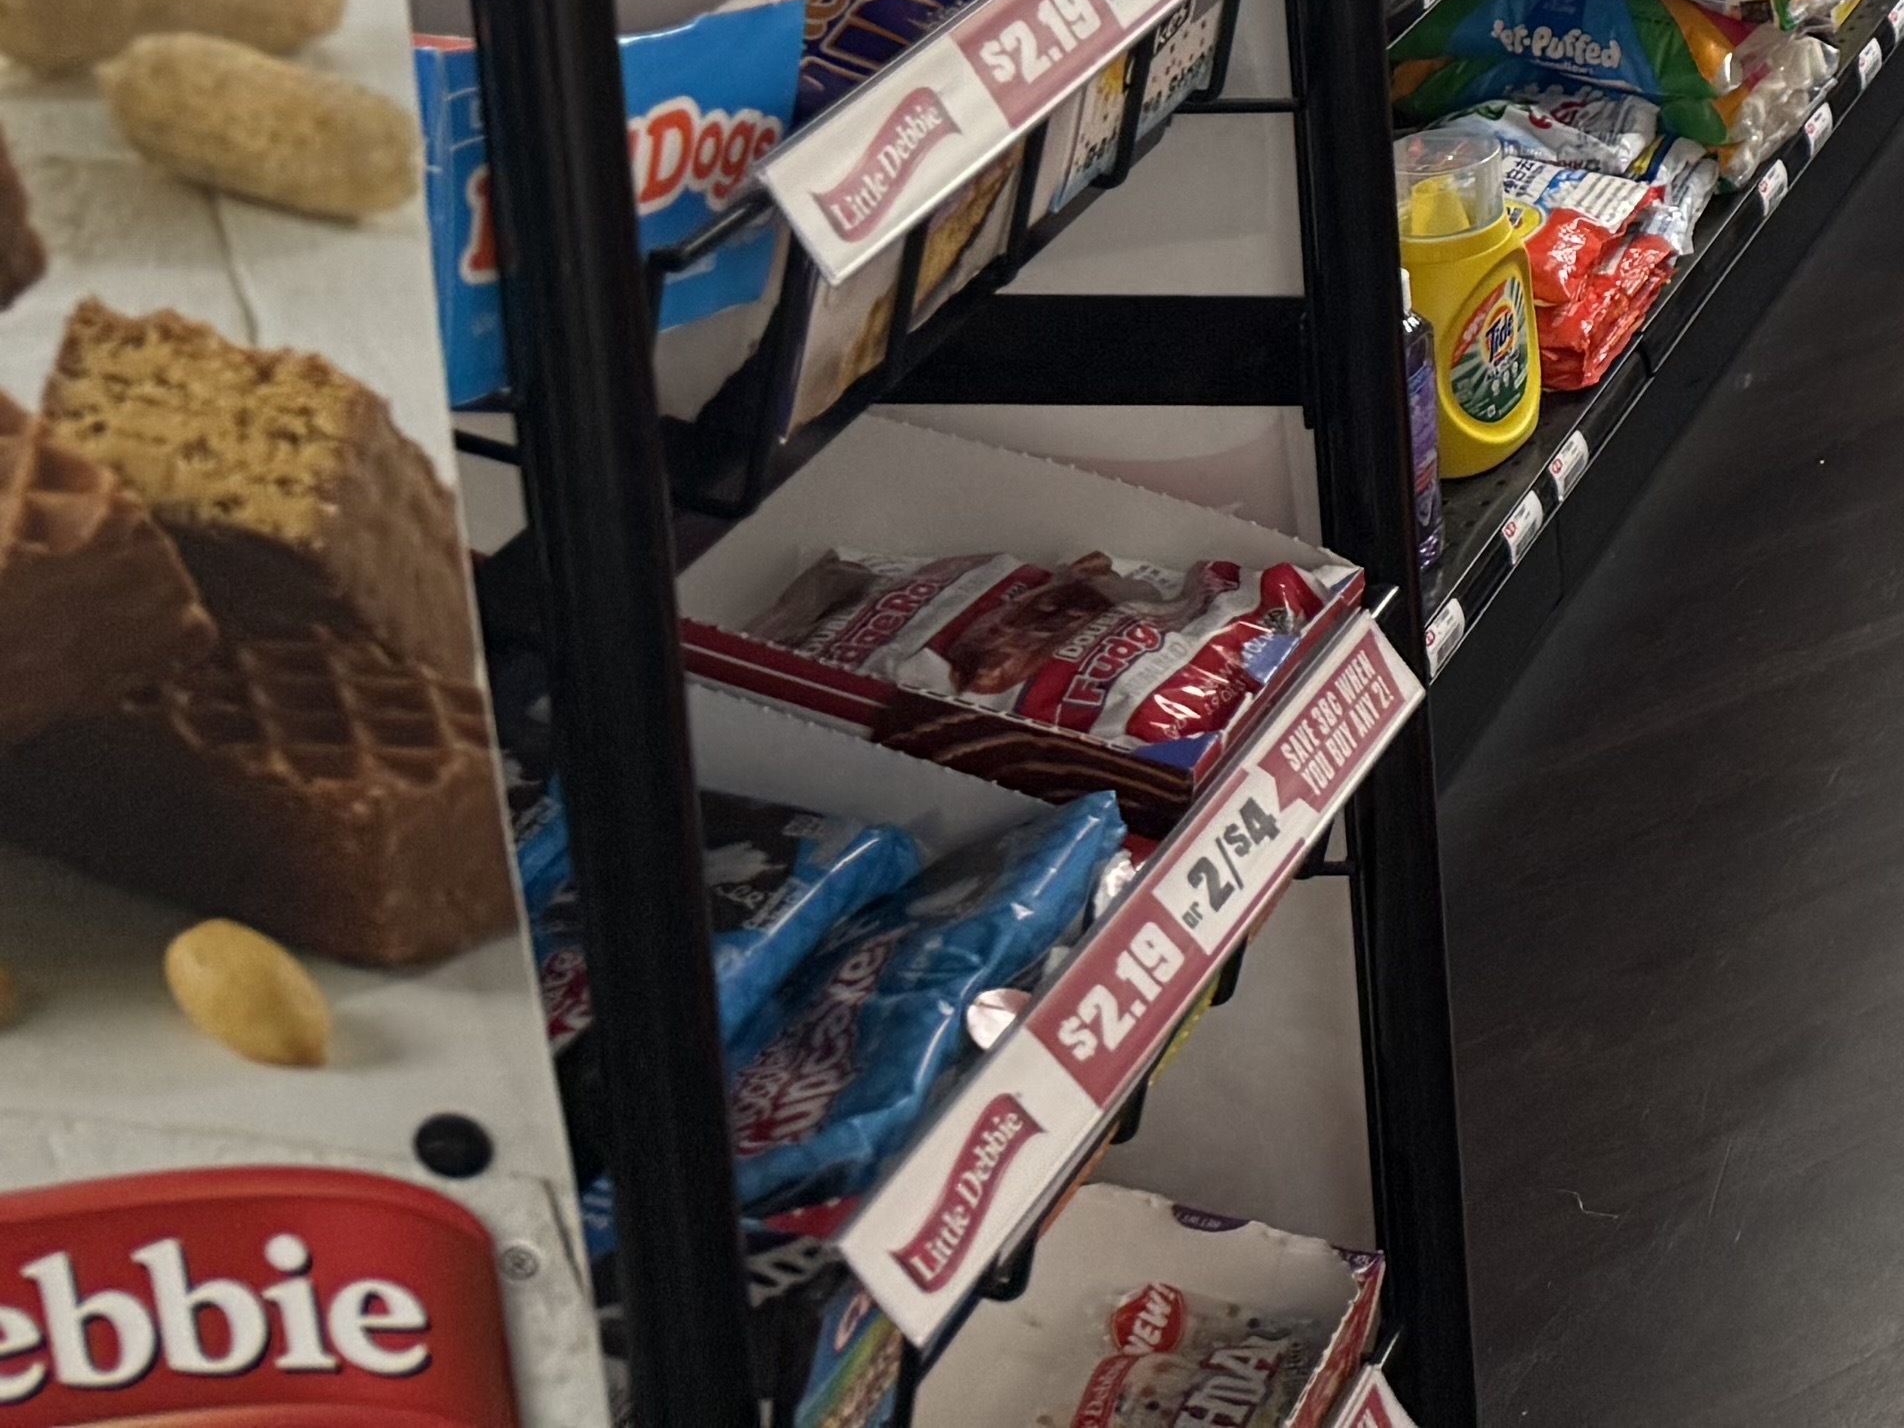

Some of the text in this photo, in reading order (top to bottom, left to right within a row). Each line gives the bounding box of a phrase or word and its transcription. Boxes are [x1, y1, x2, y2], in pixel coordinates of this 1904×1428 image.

[830, 97, 944, 231] Little Debbie
[1485, 309, 1515, 363] Tide
[1280, 649, 1375, 774] SAVE WHEN
[1299, 753, 1335, 798] YOU
[1326, 726, 1357, 771] BUY
[1349, 699, 1381, 745] ANY
[1180, 795, 1283, 933] or 2/$4
[1056, 920, 1187, 1065] $2.19
[906, 1108, 1027, 1285] Little Debbie
[1121, 1280, 1185, 1360] NEW!
